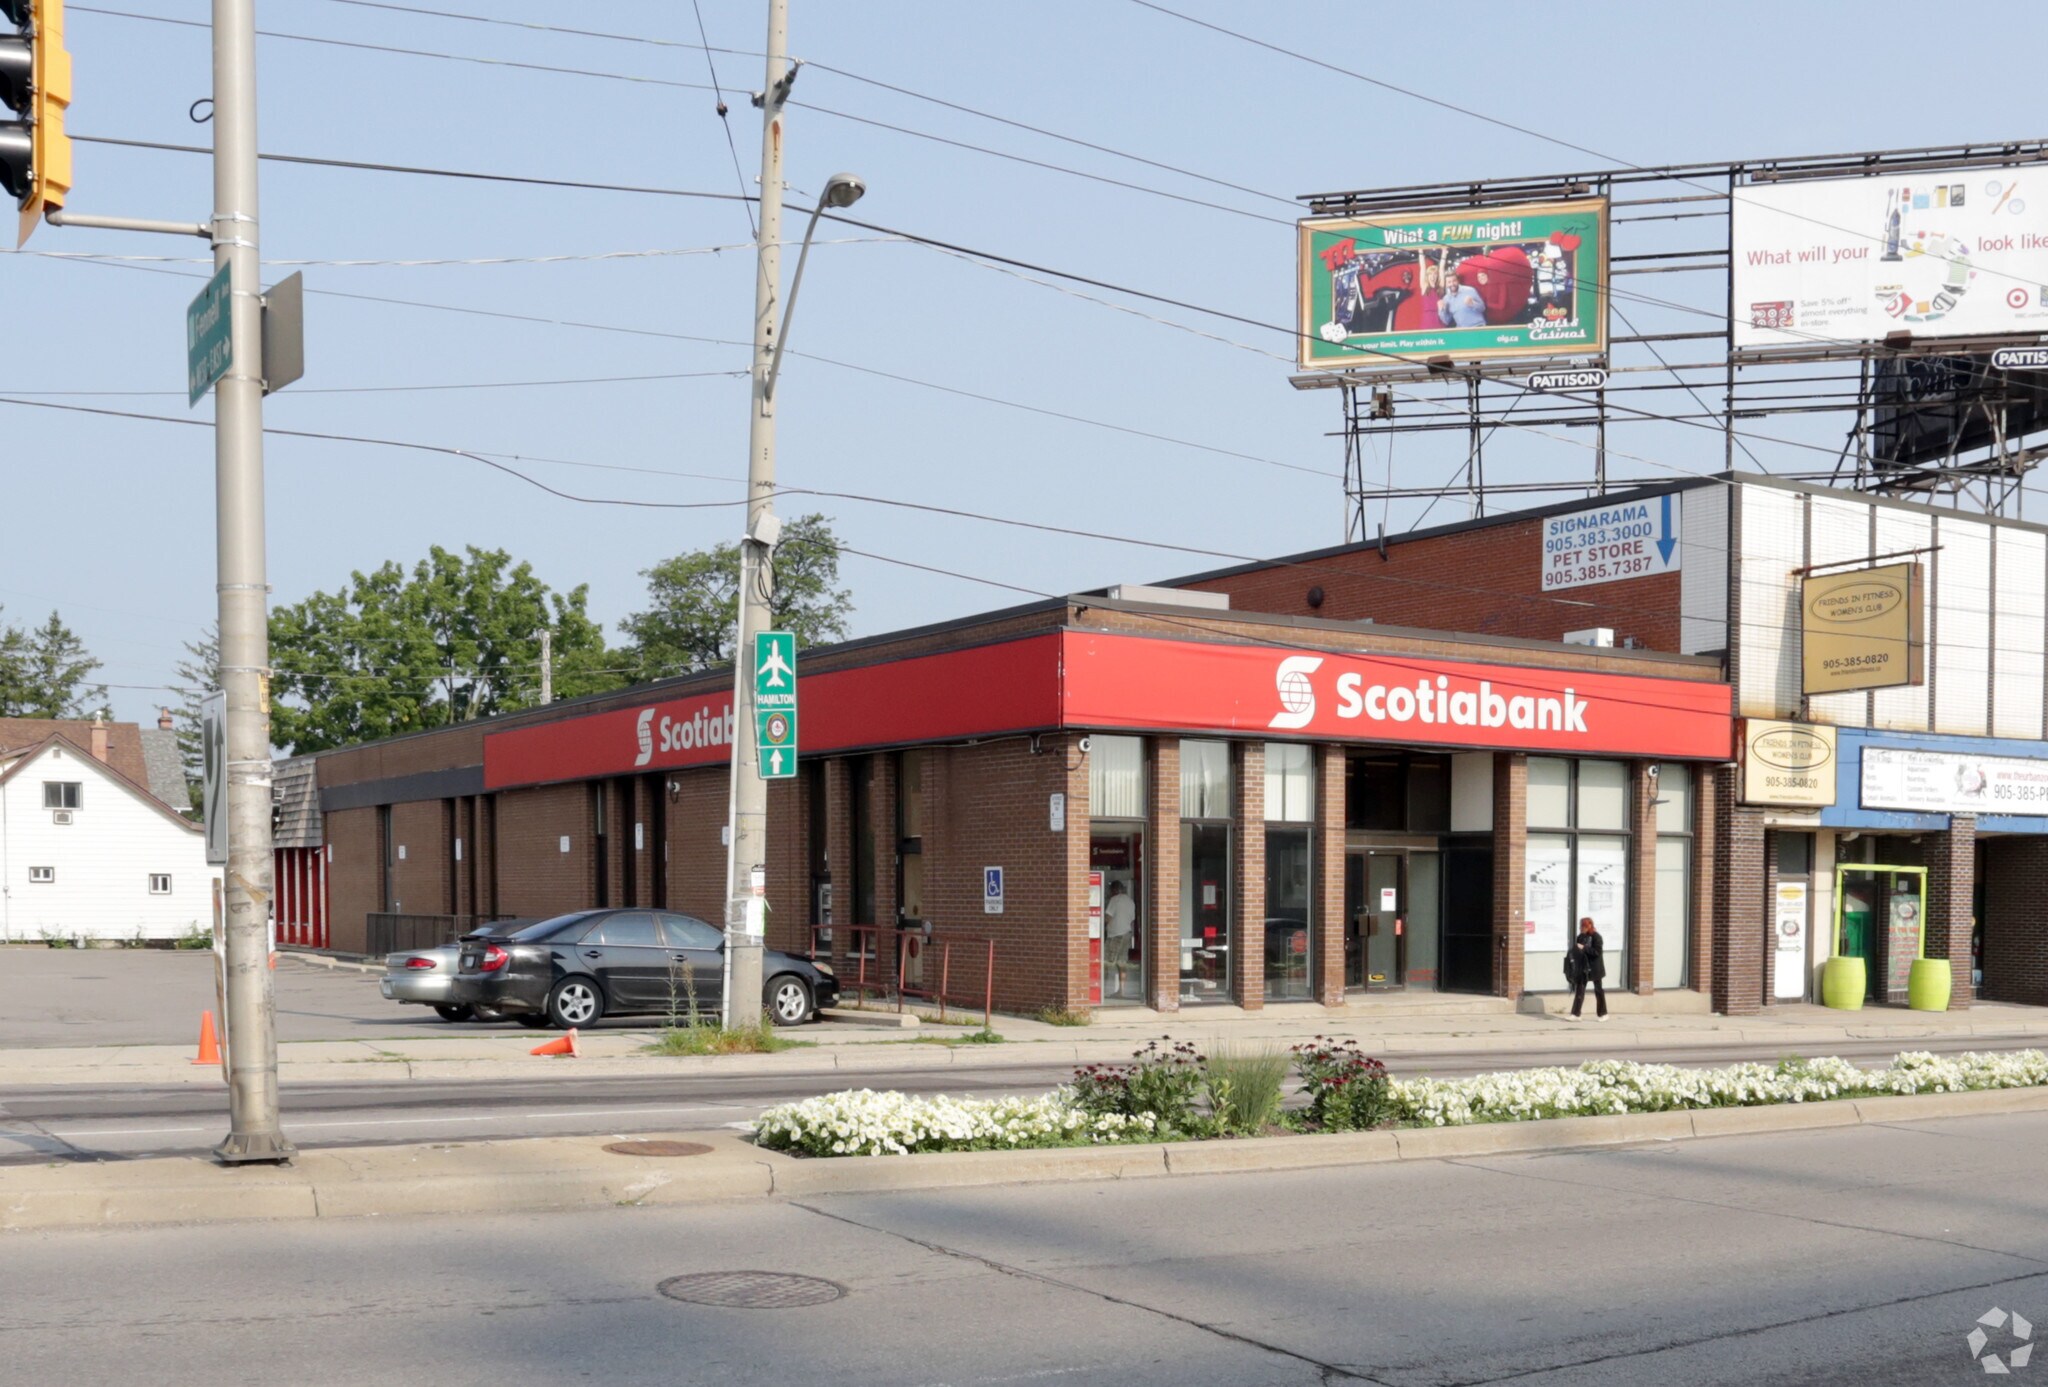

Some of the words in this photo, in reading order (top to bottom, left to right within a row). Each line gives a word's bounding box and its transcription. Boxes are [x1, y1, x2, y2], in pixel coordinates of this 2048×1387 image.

[1383, 227, 1424, 245] What
[1428, 229, 1437, 242] a
[1441, 224, 1474, 241] FUN
[1476, 220, 1522, 241] night!
[1747, 247, 1792, 267] What
[1797, 242, 1827, 263] will
[1832, 246, 1870, 265] your
[1977, 234, 2014, 253] look
[2021, 233, 2048, 250] like
[1828, 306, 1868, 317] everything
[1529, 328, 1587, 341] Casinos
[1399, 339, 1415, 349] Play
[1998, 351, 2048, 365] PATTIS
[1532, 372, 1601, 388] PATTISON
[1550, 504, 1649, 536] SIGNARAMA
[1546, 521, 1653, 553] 905.383.3000
[1553, 550, 1582, 568] PET
[1588, 540, 1644, 562] STORE
[1545, 556, 1653, 586] 905.385.7387
[1818, 596, 1849, 607] FRIENDS
[1851, 594, 1861, 603] IN
[1863, 590, 1895, 601] FITNESS
[1865, 603, 1883, 613] CLUB
[1823, 653, 1889, 670] 905-385-0820
[757, 694, 794, 705] HAMILTON
[1336, 672, 1588, 733] Scotiabank
[660, 704, 735, 753] Scotiab
[1765, 776, 1818, 789] 905-385-0820
